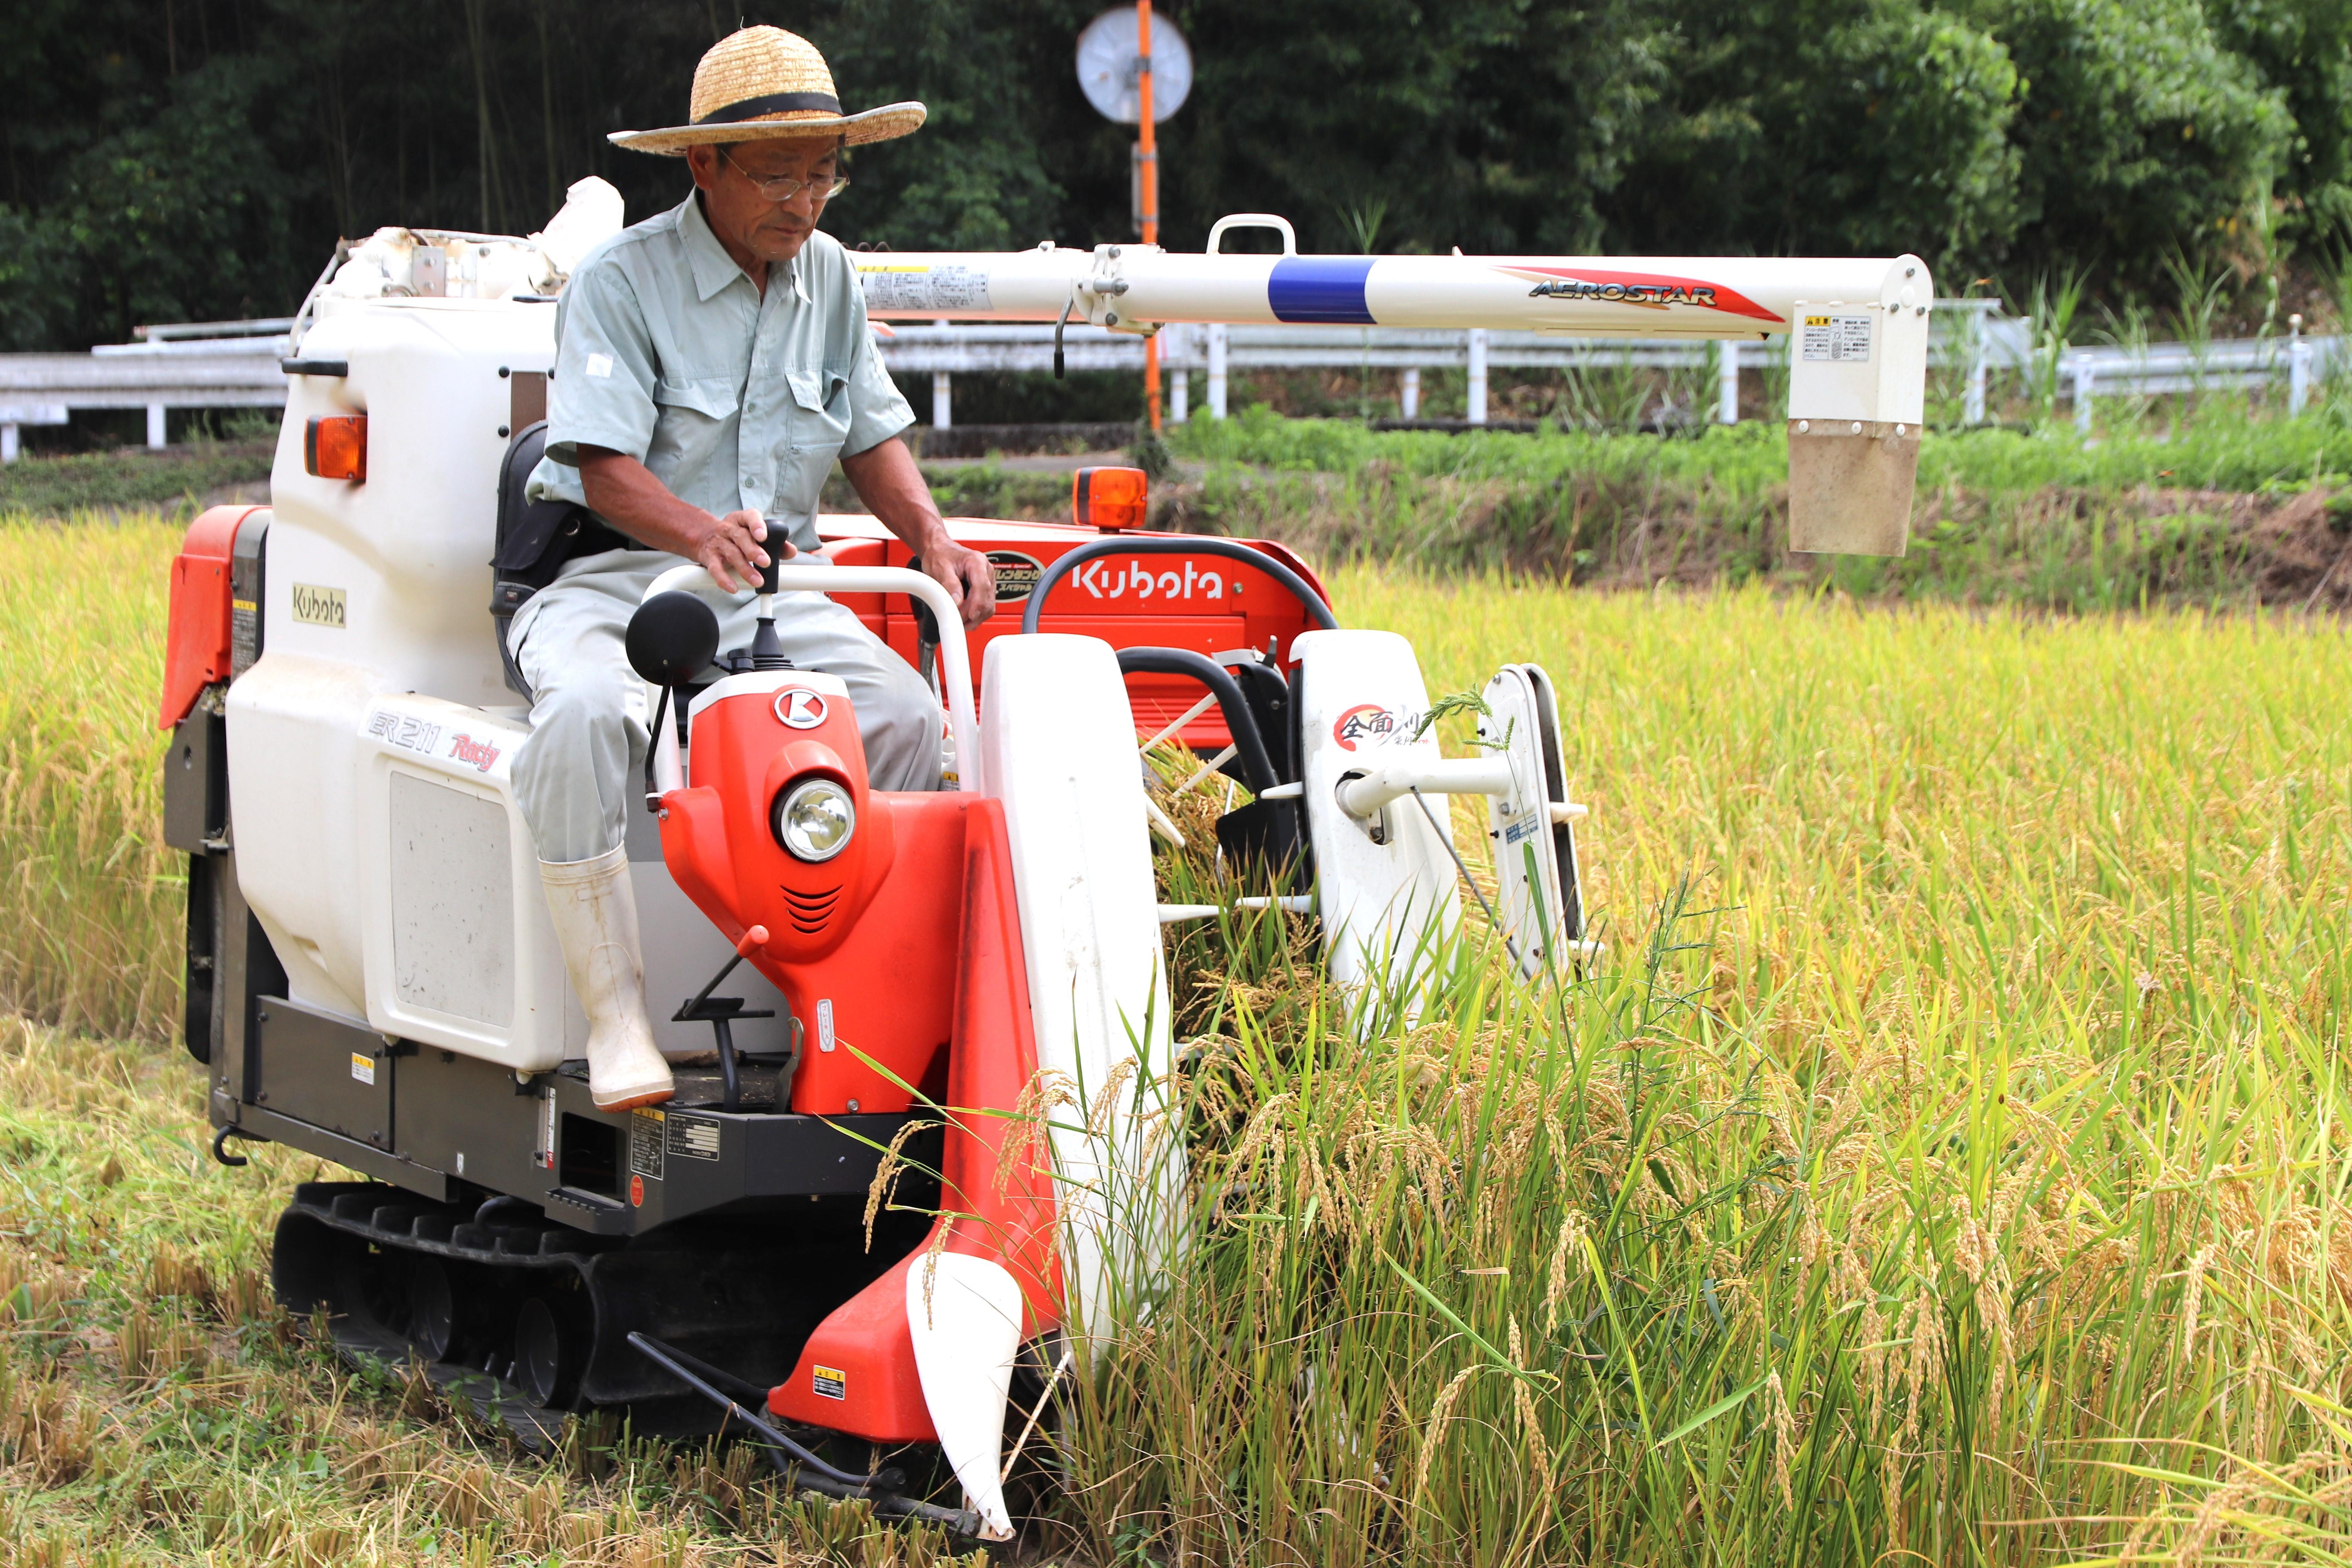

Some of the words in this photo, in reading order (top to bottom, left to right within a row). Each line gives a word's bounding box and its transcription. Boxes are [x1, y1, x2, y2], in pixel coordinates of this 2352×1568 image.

[1529, 279, 1717, 306] AEROSTAR
[1072, 560, 1222, 599] Kubota
[294, 586, 344, 624] Kubota
[448, 733, 501, 772] Racty
